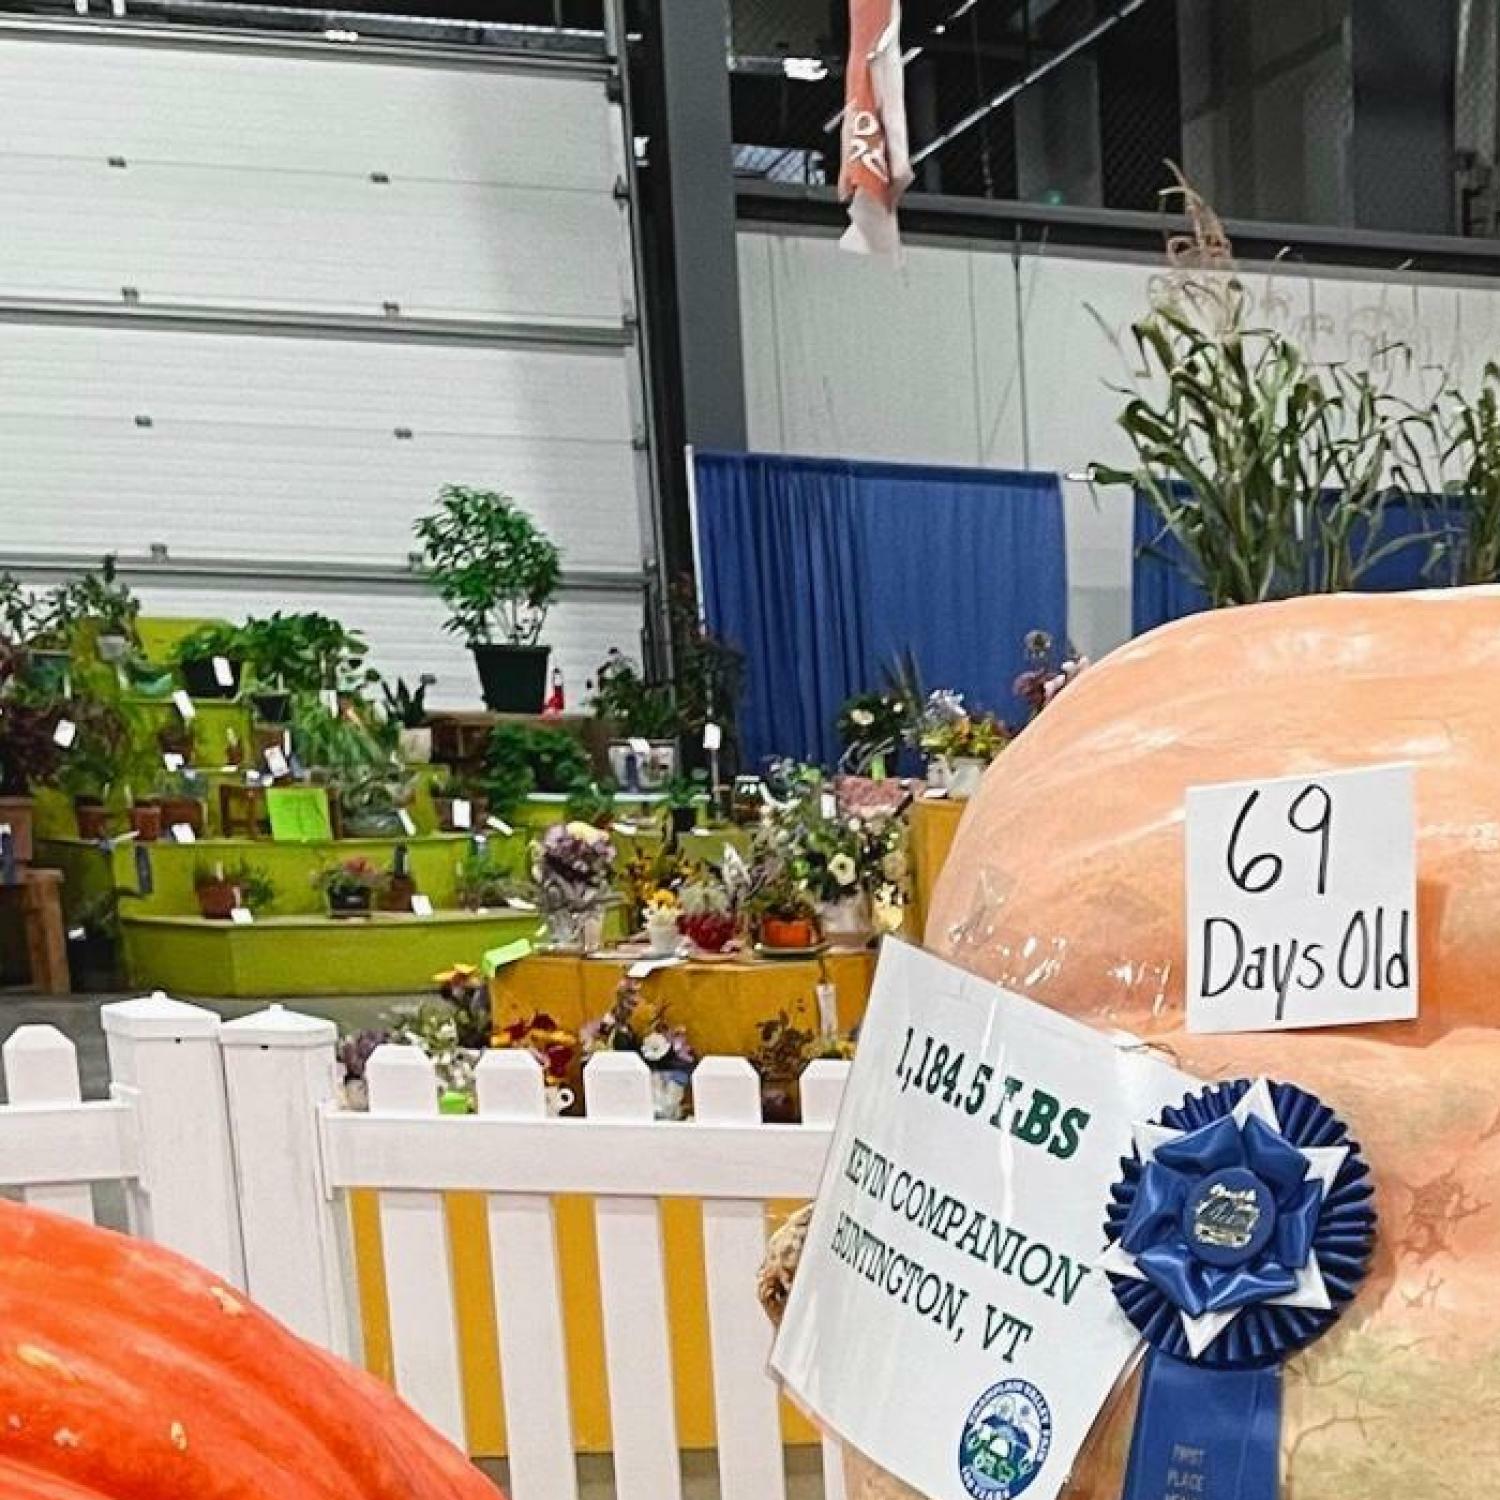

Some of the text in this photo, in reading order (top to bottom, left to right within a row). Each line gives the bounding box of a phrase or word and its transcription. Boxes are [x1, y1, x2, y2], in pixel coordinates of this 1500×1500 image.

[1227, 783, 1332, 895] 69
[1200, 905, 1410, 1021] Days Old
[896, 1026, 995, 1116] 1,184.5
[830, 1210, 1034, 1364] HUNTINGTON, VT
[890, 1169, 1092, 1306] COMPANION
